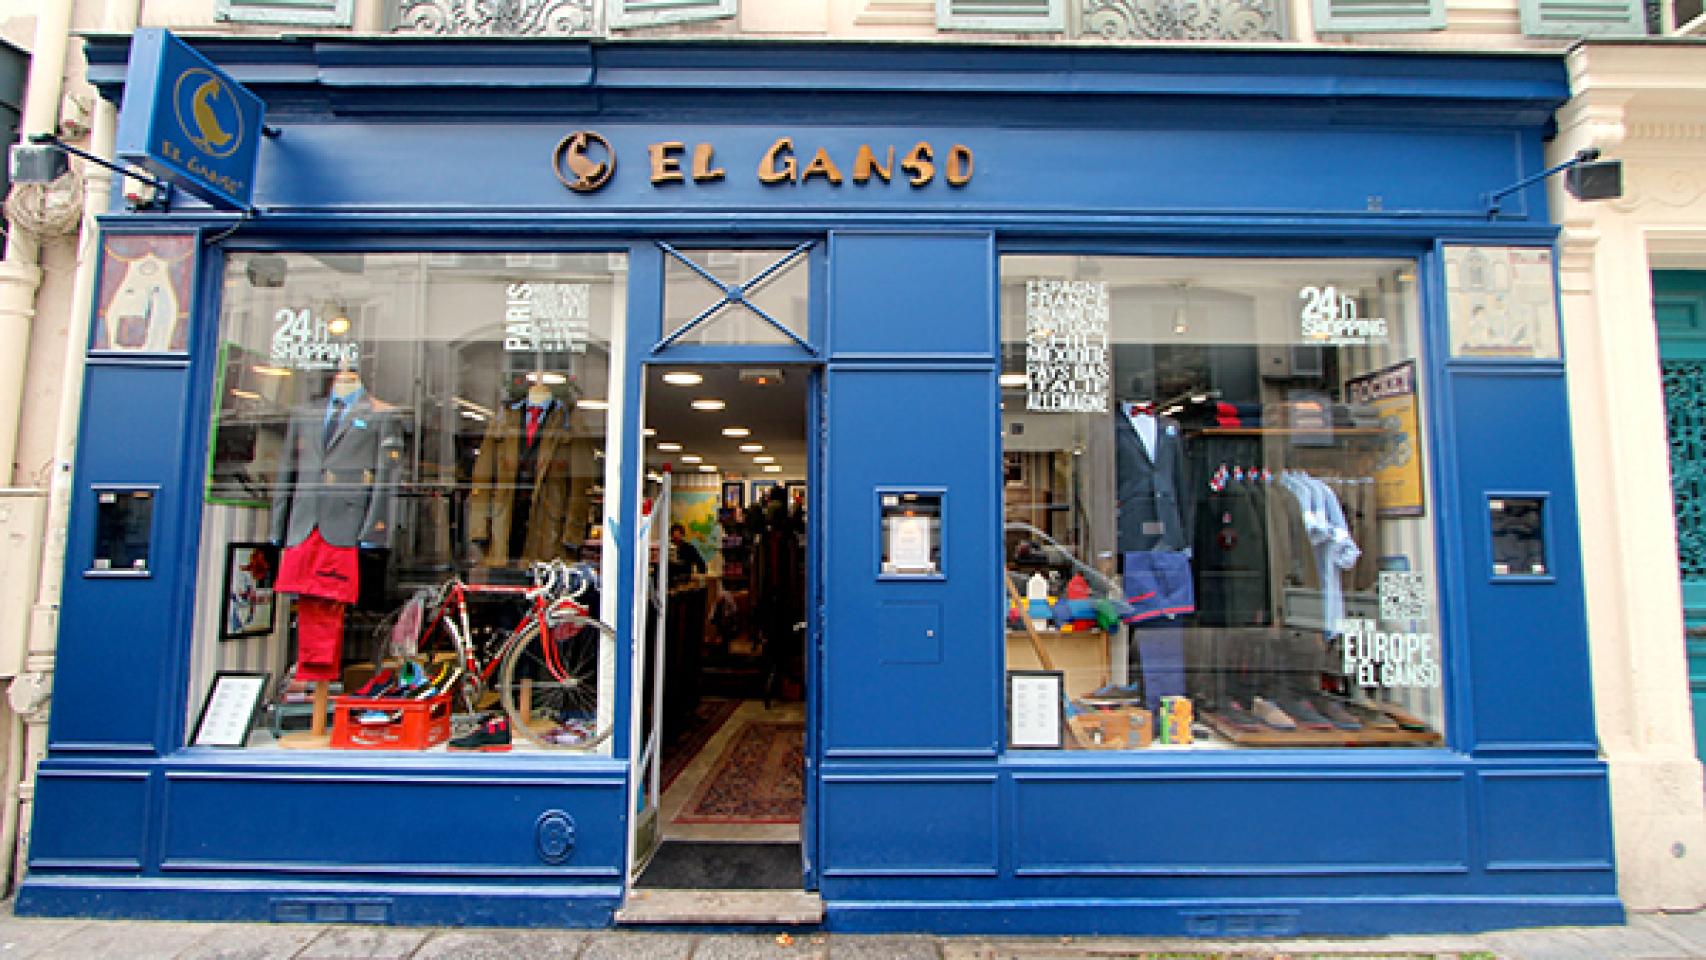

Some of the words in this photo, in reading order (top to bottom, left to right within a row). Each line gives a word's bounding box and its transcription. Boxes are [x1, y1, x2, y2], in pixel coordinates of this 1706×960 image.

[648, 140, 726, 185] EL
[758, 136, 975, 187] GANSO
[505, 283, 532, 350] PARIS
[1301, 319, 1388, 336] SHOPPING
[271, 342, 359, 361] SHOPPING
[1344, 632, 1434, 662] EUROPE
[1380, 663, 1440, 688] GANSO
